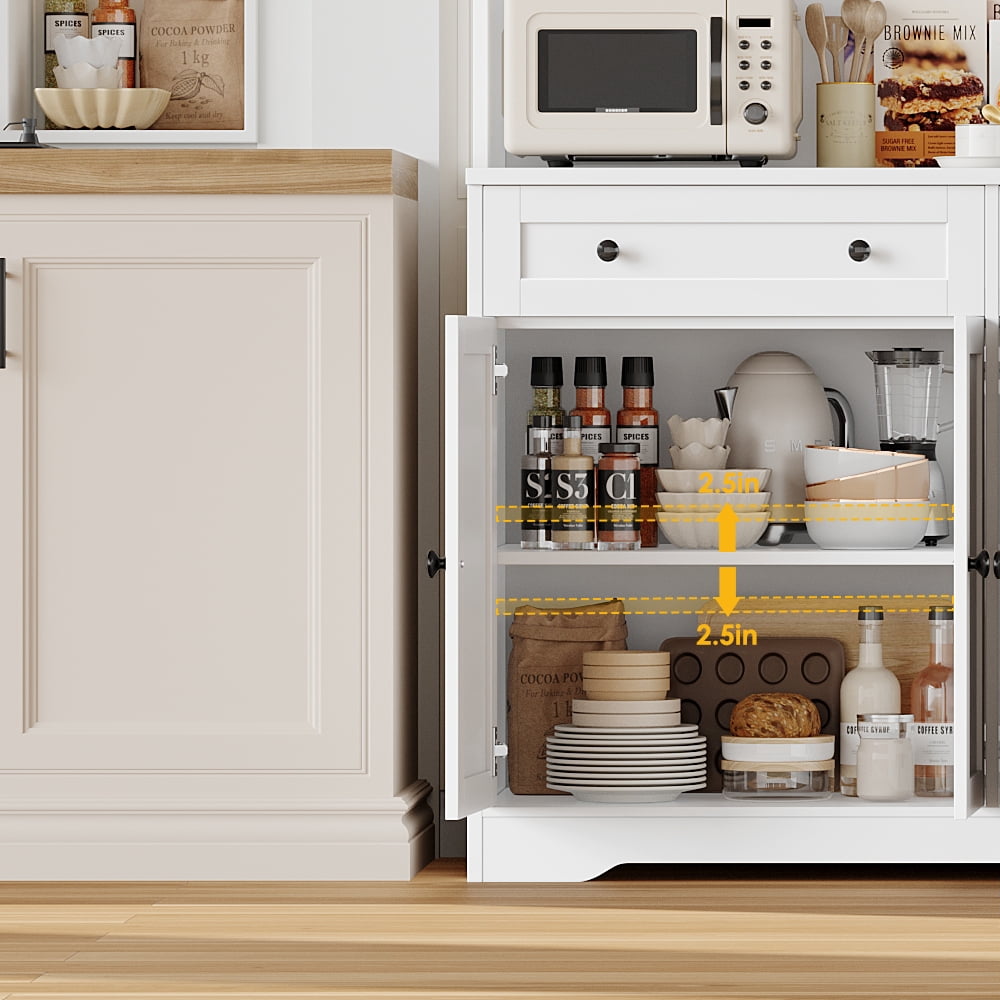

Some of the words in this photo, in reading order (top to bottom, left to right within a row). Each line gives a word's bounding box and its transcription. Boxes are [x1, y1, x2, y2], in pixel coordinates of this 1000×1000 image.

[54, 20, 82, 28] SPICES
[151, 26, 189, 37] COCOA
[190, 23, 236, 36] POWDER
[884, 24, 945, 41] BROWNIE
[953, 24, 977, 41] MIX
[181, 50, 187, 65] 1
[193, 49, 210, 69] kg
[556, 472, 589, 500] S3
[605, 472, 637, 500] C1
[520, 673, 560, 685] COCOA
[553, 701, 559, 718] 1
[917, 725, 939, 735] COFFEE
